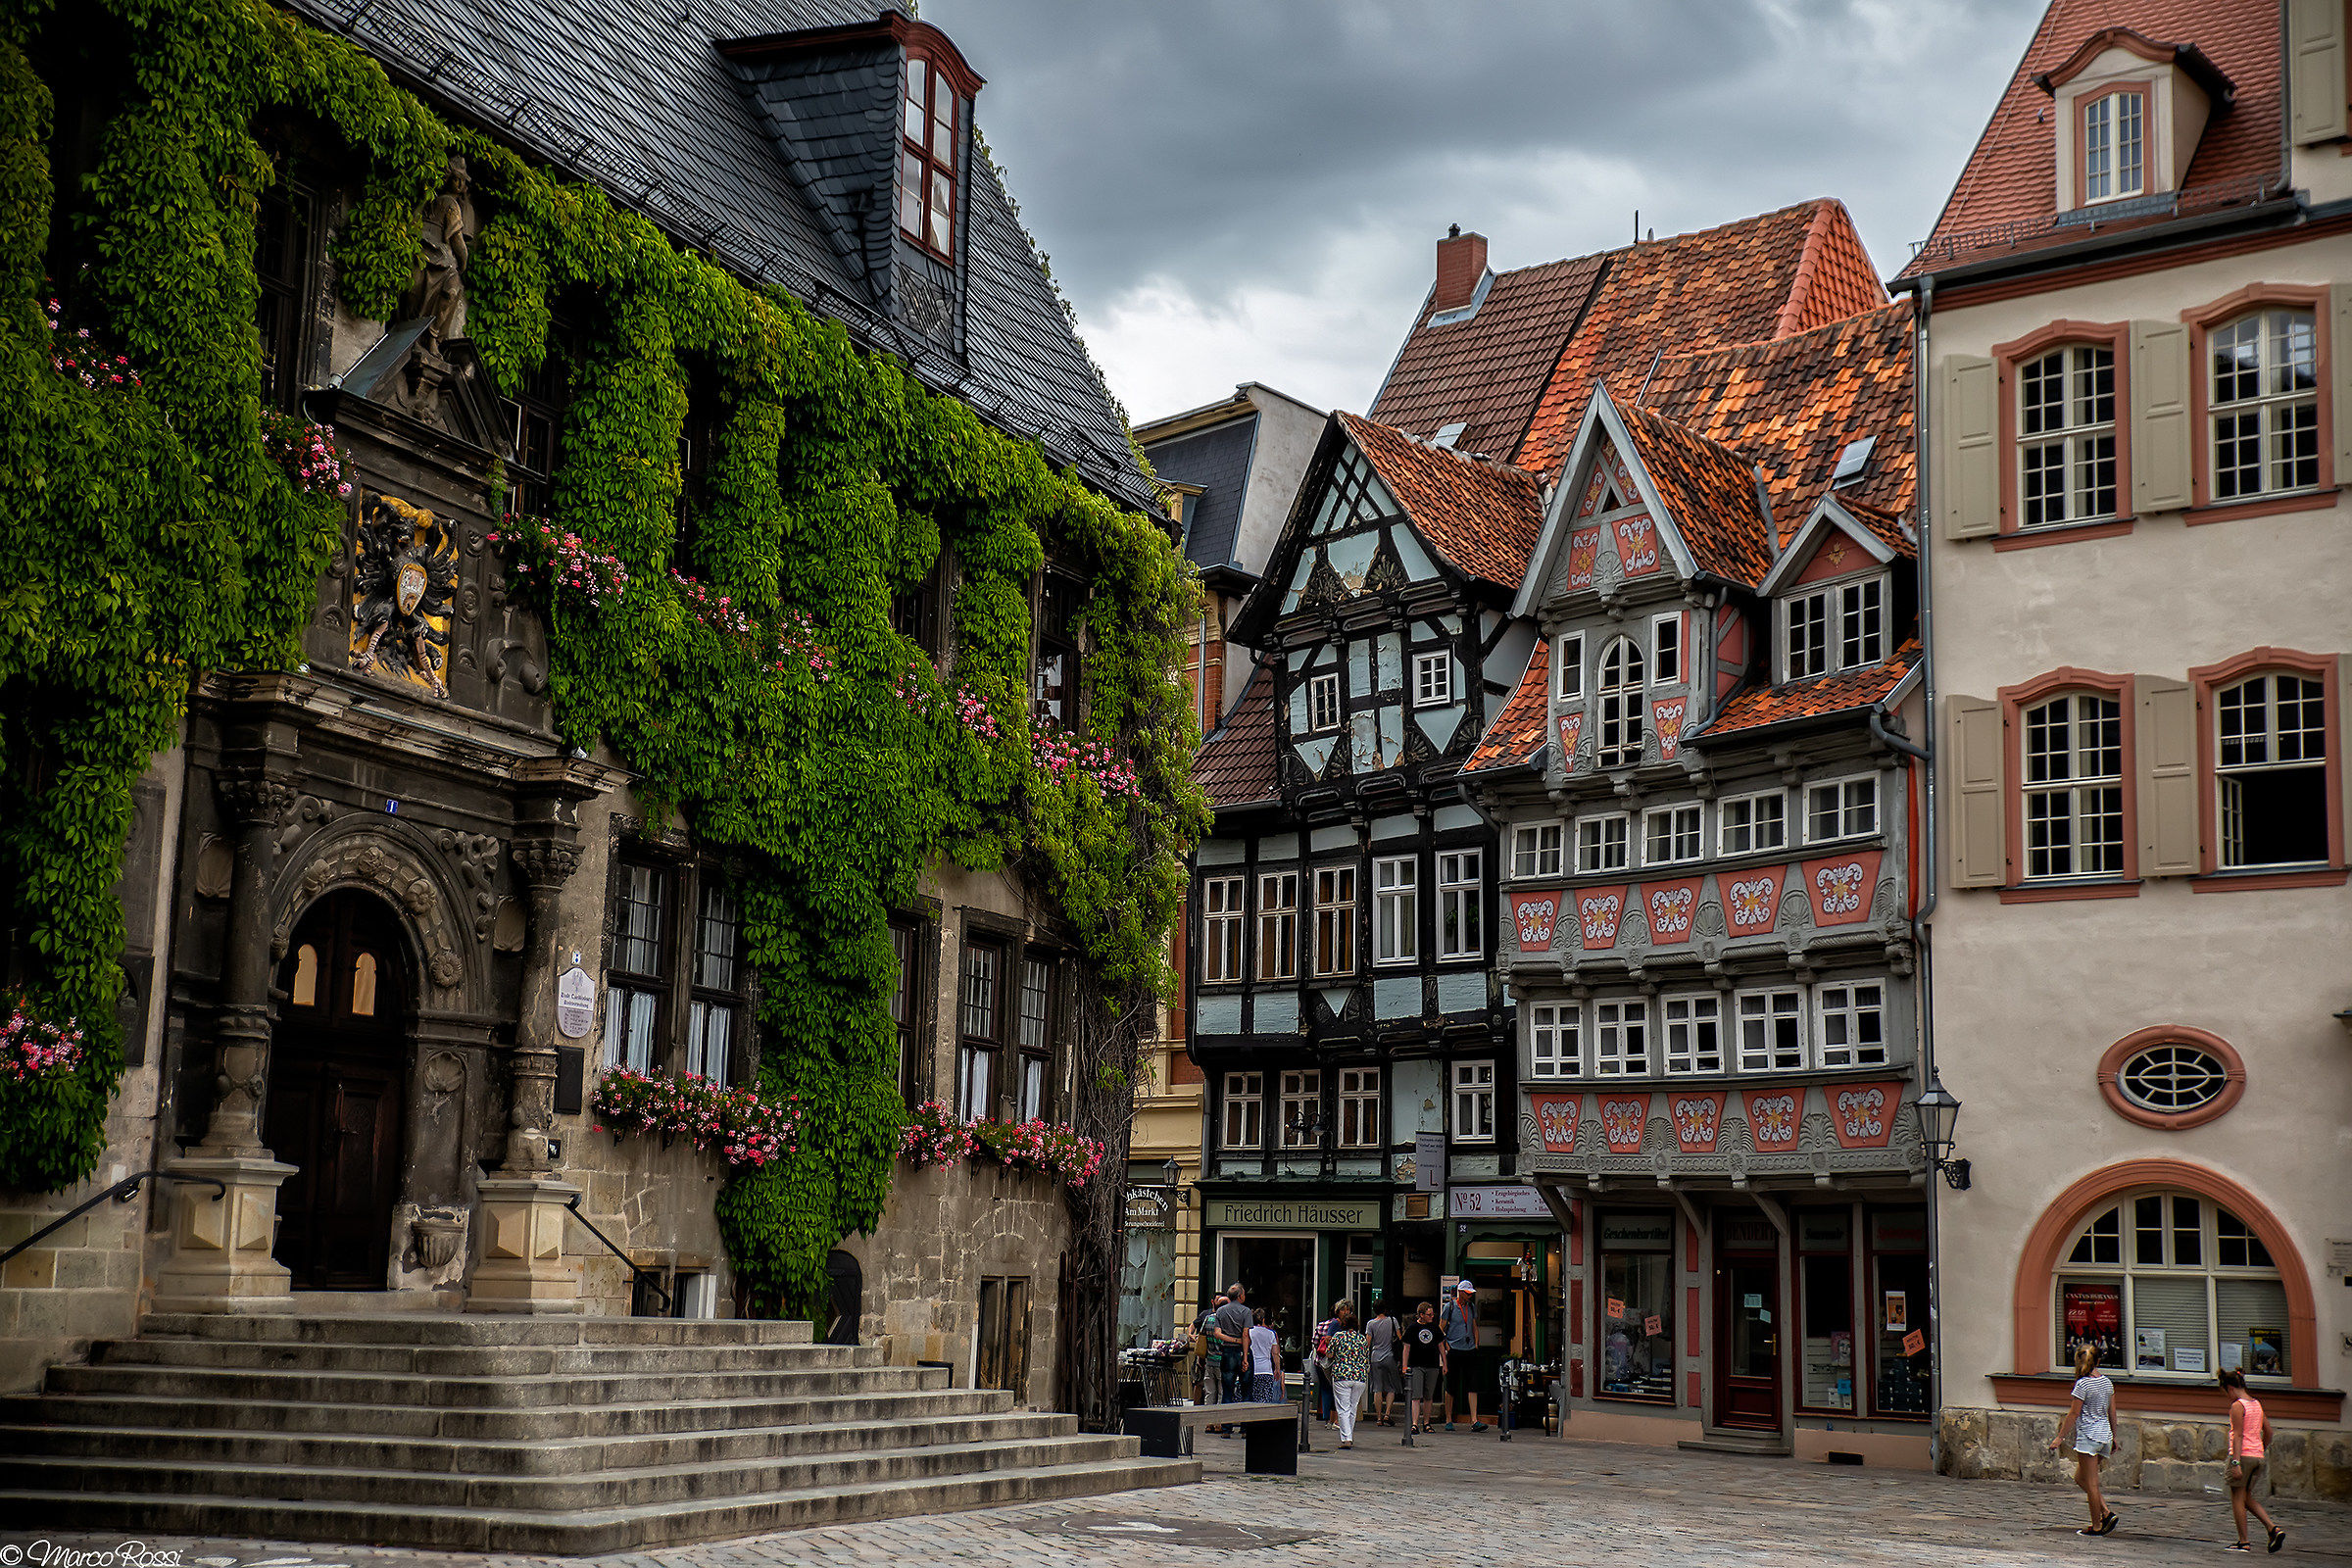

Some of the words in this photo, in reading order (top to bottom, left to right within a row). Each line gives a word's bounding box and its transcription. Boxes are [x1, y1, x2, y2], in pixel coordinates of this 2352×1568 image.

[1137, 1206, 1159, 1216] Markt
[1470, 1194, 1482, 1211] 52
[1224, 1204, 1292, 1222] Friedrich
[1298, 1204, 1363, 1223] Häusser
